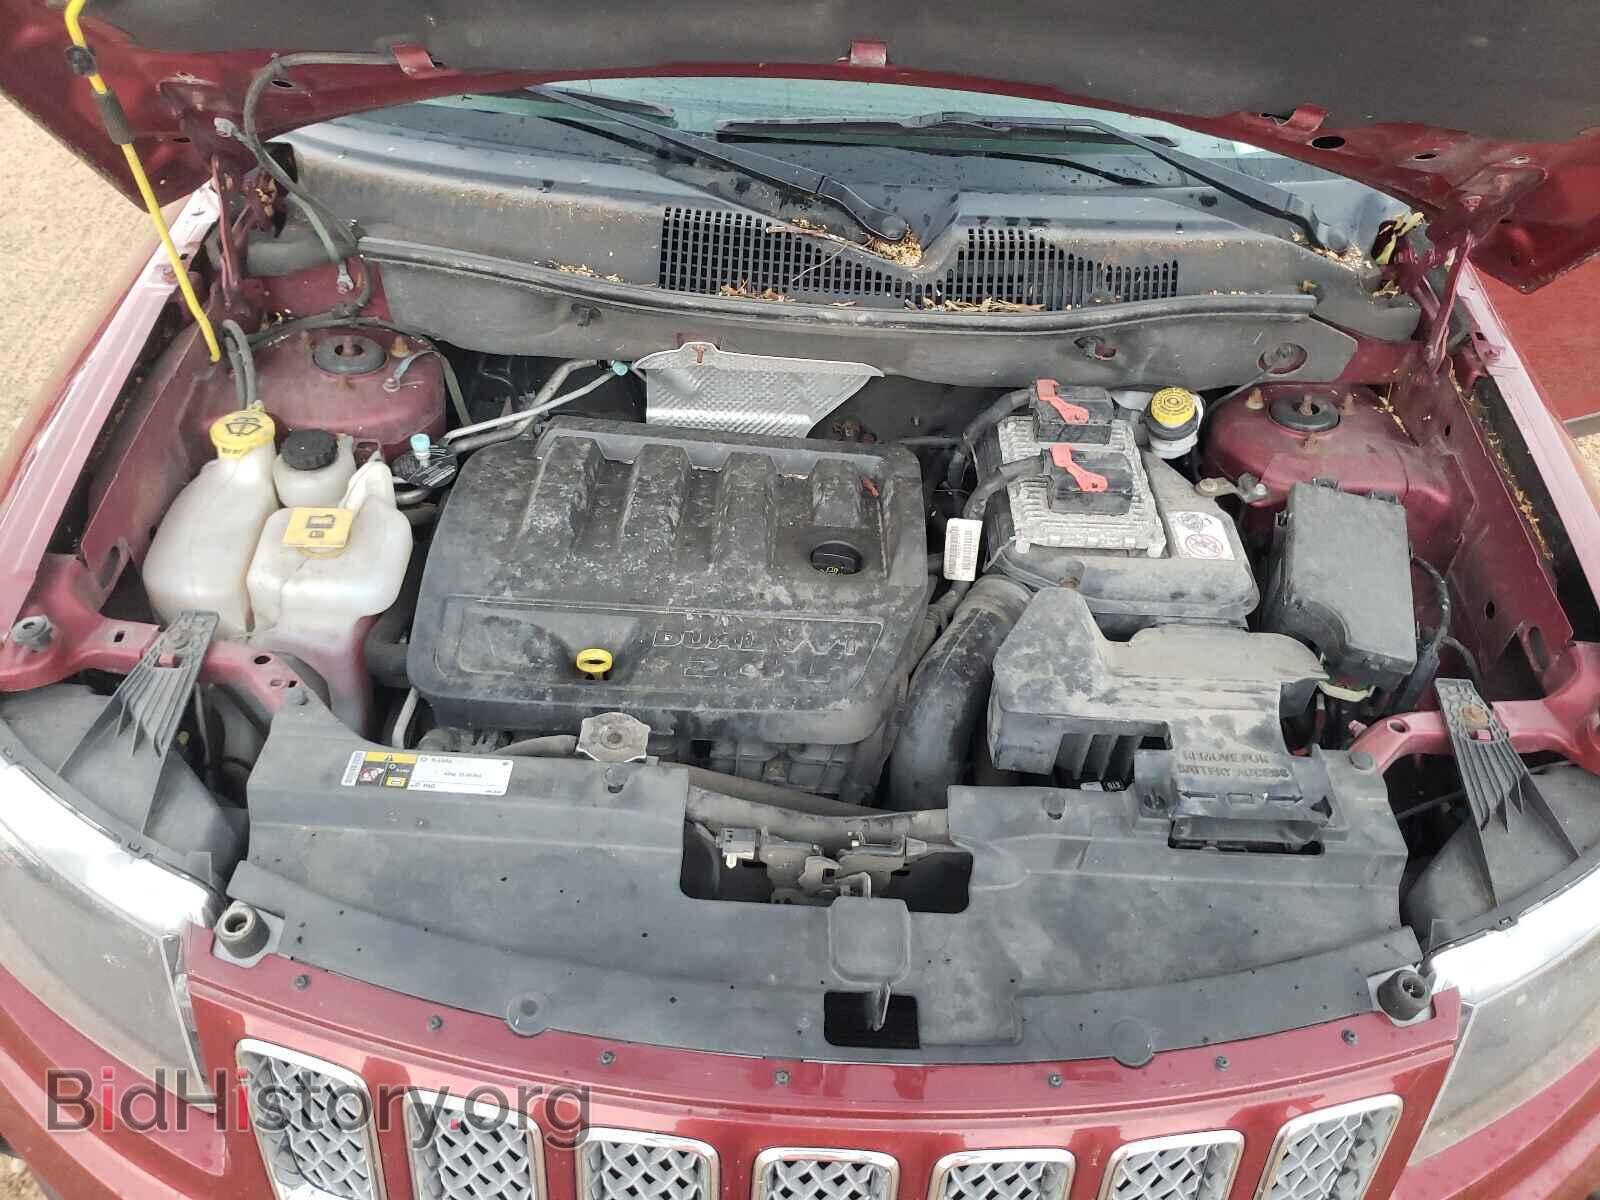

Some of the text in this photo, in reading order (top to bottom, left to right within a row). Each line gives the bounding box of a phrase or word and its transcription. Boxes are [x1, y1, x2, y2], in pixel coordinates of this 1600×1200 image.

[652, 629, 764, 653] DUAL
[1182, 751, 1238, 764] REMOVE
[1176, 764, 1291, 779] BATTERY ACCESS
